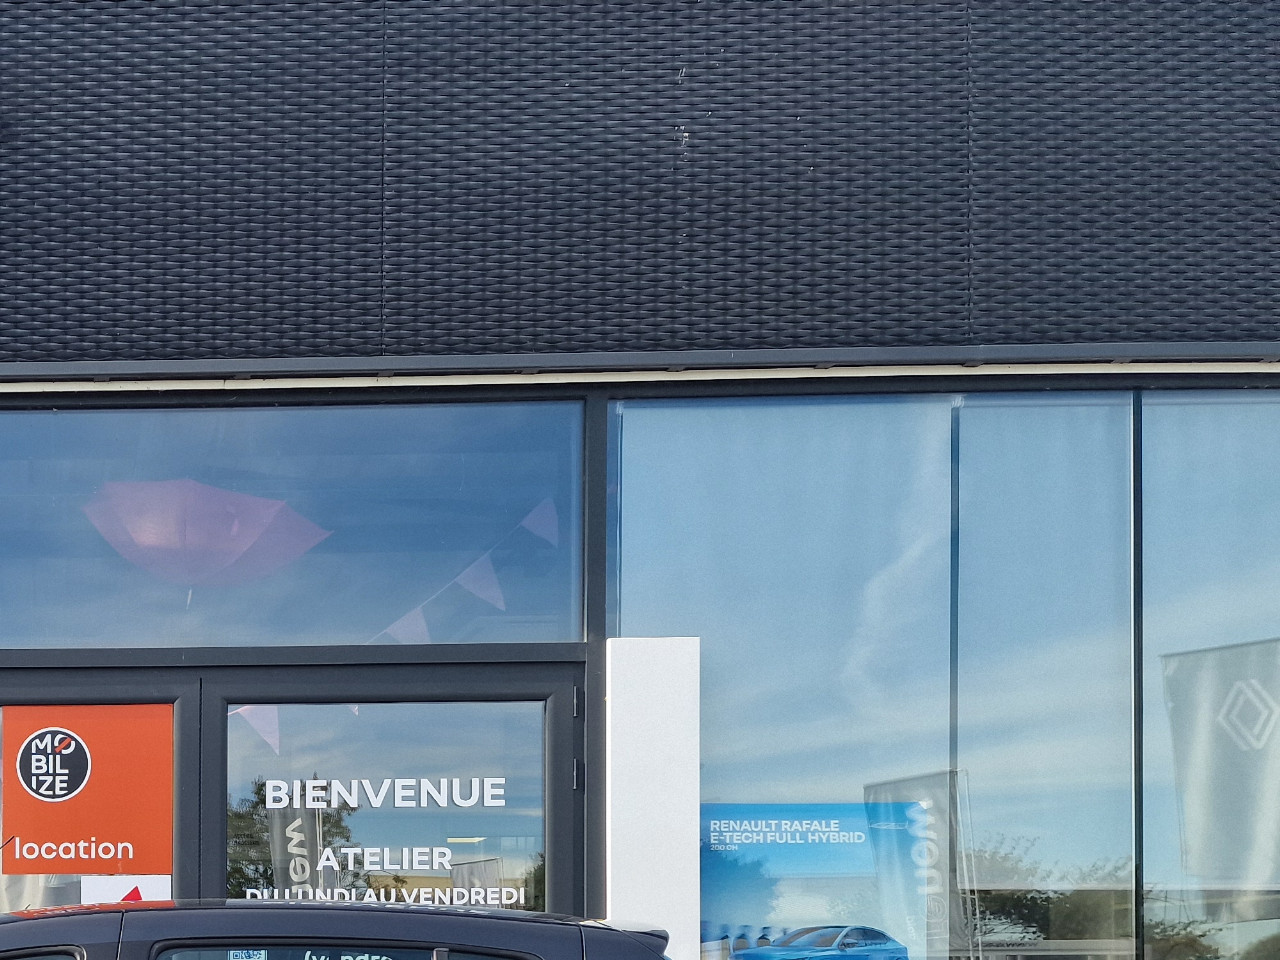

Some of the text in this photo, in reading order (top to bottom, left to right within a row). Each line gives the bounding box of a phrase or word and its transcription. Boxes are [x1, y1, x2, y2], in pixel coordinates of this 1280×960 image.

[265, 777, 507, 809] BIENVENUE
[710, 820, 840, 832] RENAULT RAFALE
[15, 836, 134, 860] location
[710, 832, 866, 844] E-TECH FULL HYBRID
[316, 847, 452, 871] ATELIER
[362, 888, 396, 904] AU
[400, 887, 525, 905] VENDREDI
